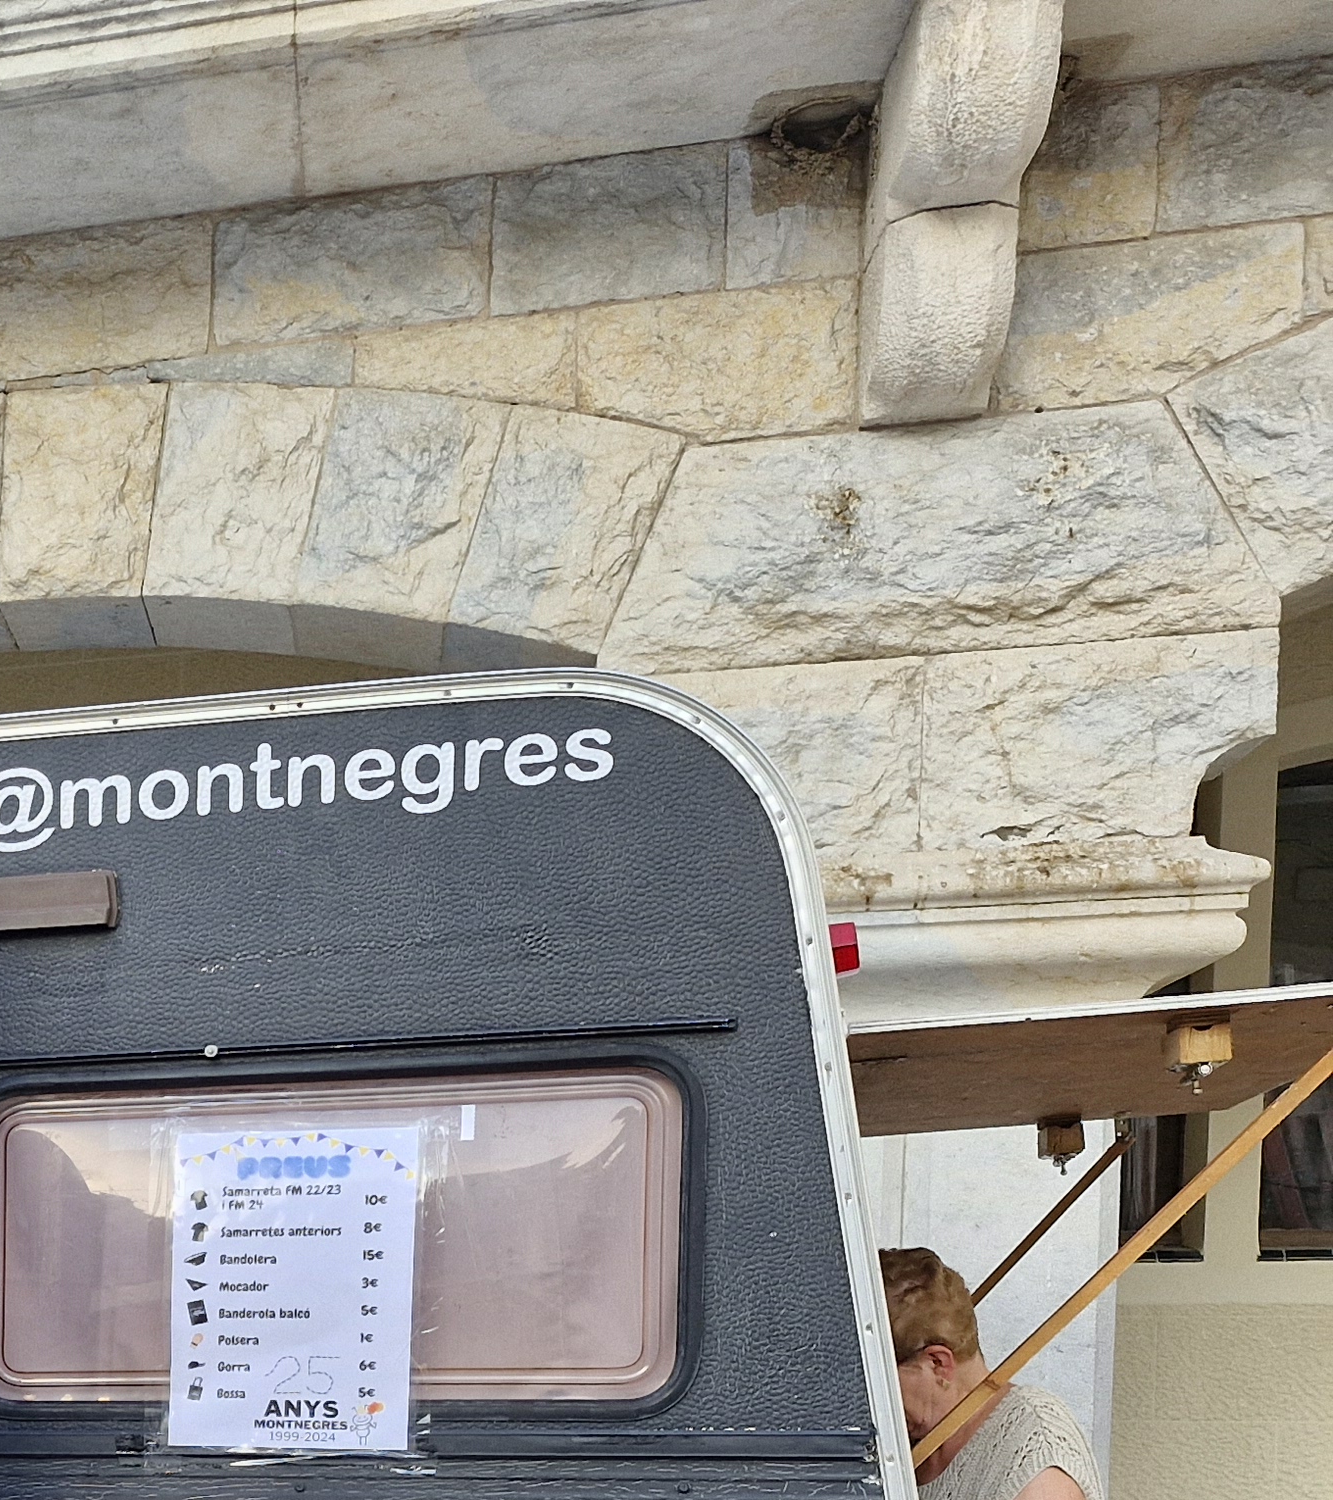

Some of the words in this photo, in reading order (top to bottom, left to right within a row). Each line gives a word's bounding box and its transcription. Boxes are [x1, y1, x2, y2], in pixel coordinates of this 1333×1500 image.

[237, 1155, 352, 1180] PREUS
[222, 1186, 282, 1198] Samarreta
[285, 1185, 303, 1196] FM
[306, 1184, 342, 1196] 22/23
[364, 1194, 389, 1206] 10€
[228, 1200, 245, 1210] FM
[248, 1200, 264, 1210] 24
[220, 1226, 285, 1238] Samarretes
[288, 1225, 342, 1237] anteriors
[363, 1222, 383, 1234] 8€
[219, 1254, 277, 1265] Bandolera
[362, 1249, 384, 1261] 15€
[219, 1281, 269, 1292] Mocador
[361, 1277, 379, 1288] 3€
[218, 1308, 276, 1319] Banderola
[279, 1307, 311, 1319] balcó
[361, 1305, 379, 1316] 5€
[217, 1335, 260, 1346] Polsera
[360, 1332, 375, 1343] 1€
[217, 1361, 251, 1373] Gorra
[359, 1360, 377, 1371] 6€
[264, 1355, 341, 1396] 25
[217, 1388, 246, 1399] Bossa
[358, 1387, 376, 1398] 5€
[263, 1399, 339, 1419] ANYS
[253, 1419, 348, 1431] MONTNEGRES
[268, 1431, 336, 1443] 1999-2024
